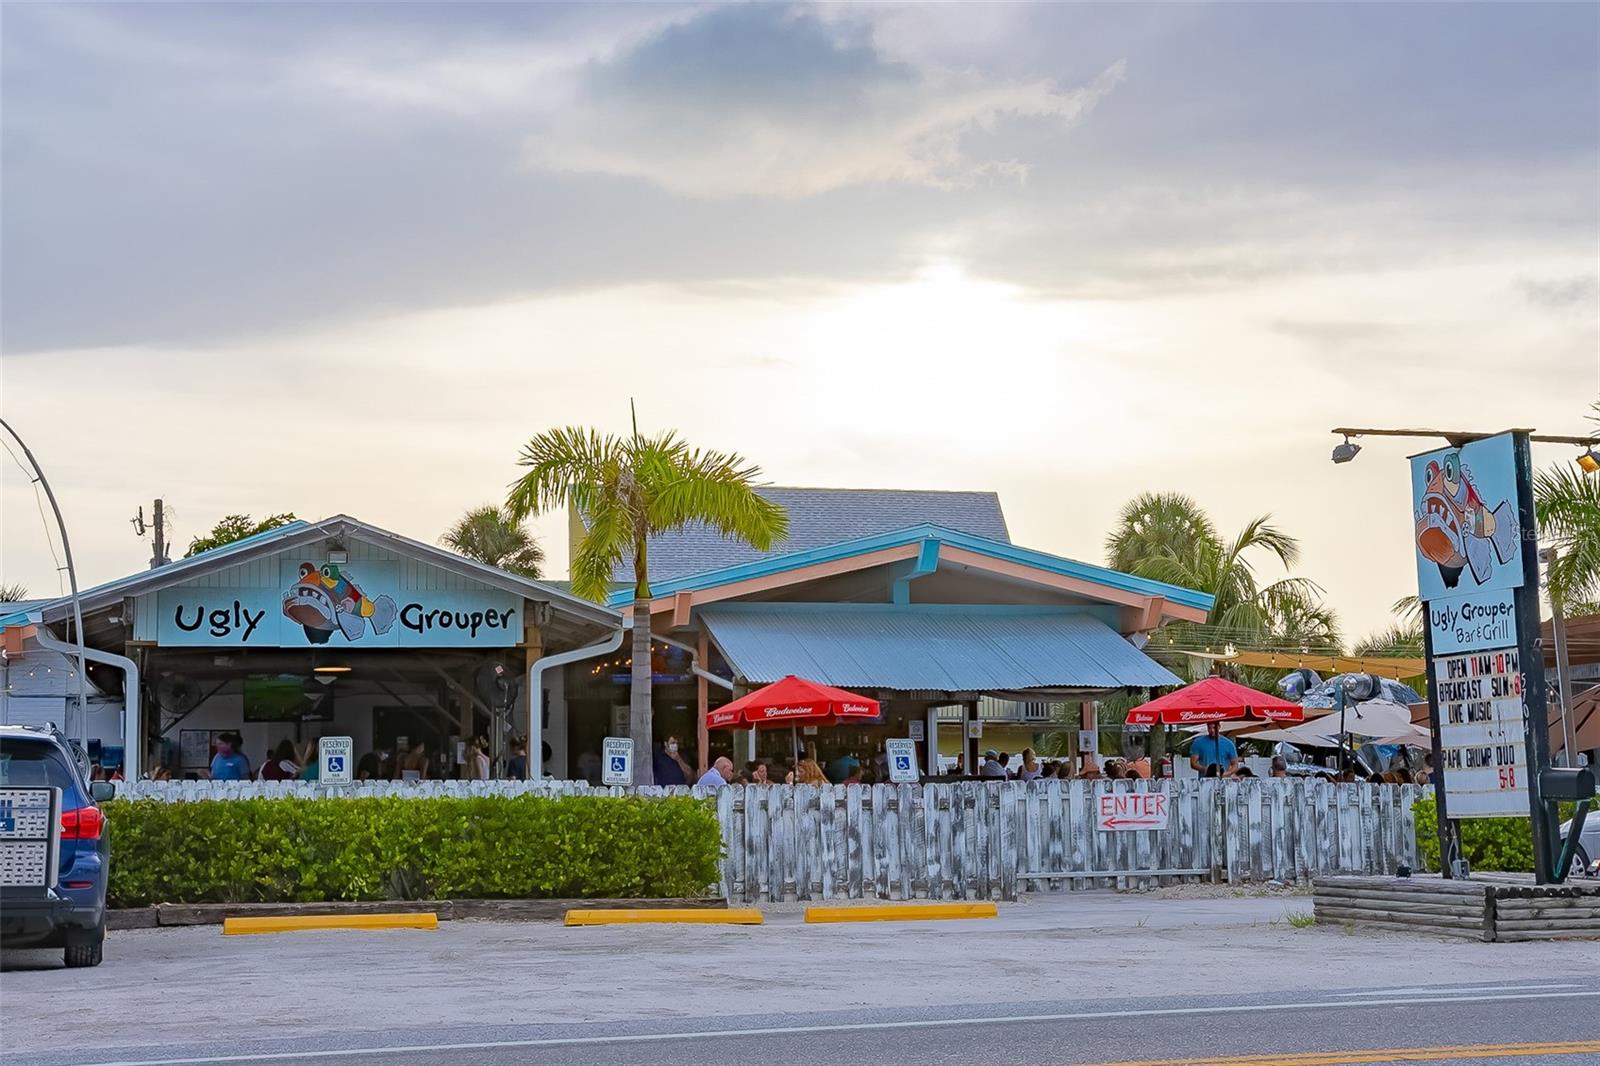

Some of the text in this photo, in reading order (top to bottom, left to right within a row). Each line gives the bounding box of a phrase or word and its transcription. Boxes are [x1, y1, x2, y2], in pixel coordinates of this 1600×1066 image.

[175, 600, 515, 642] Ugly Grouper
[1431, 602, 1514, 632] Ugly Grouper
[1447, 657, 1467, 679] OPEN
[1440, 679, 1482, 702] BREAKFAST
[764, 706, 813, 718] Budweiser
[1448, 701, 1492, 724] LIVE MUSIC
[607, 741, 631, 749] RESERVED
[1465, 747, 1492, 768] GRUMP
[1496, 745, 1515, 766] DUO
[1101, 794, 1167, 816] ENTER
